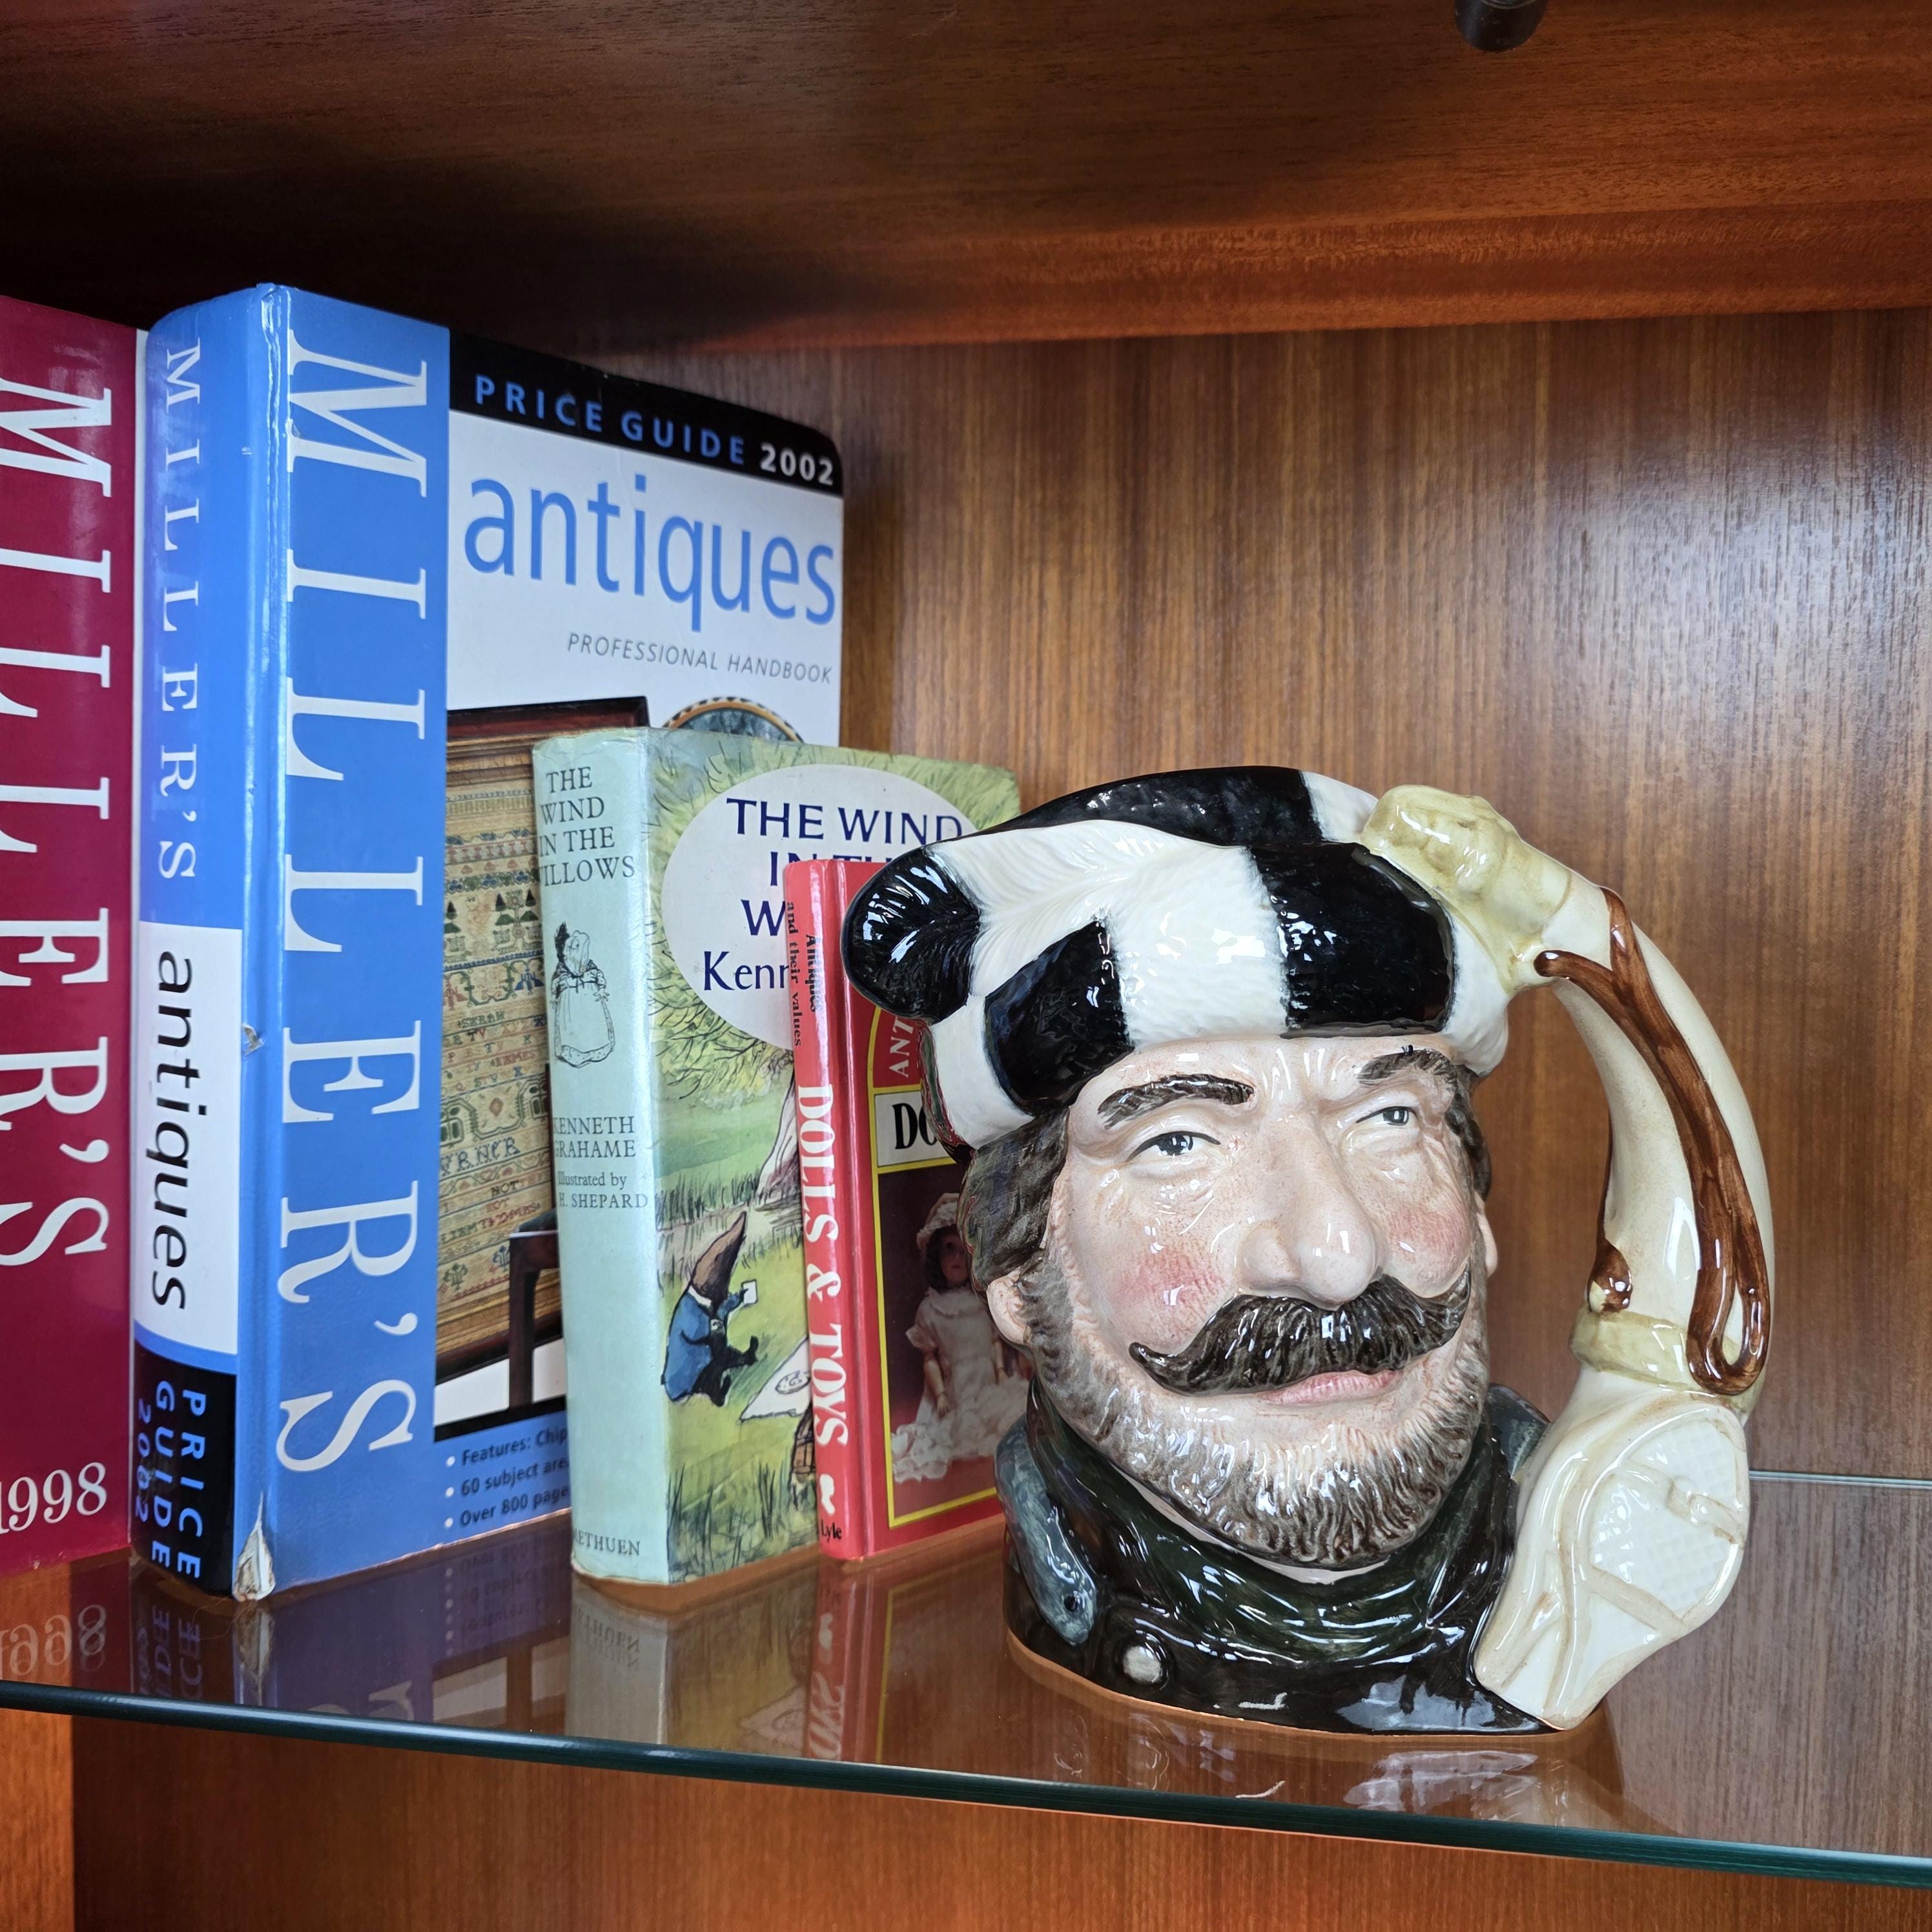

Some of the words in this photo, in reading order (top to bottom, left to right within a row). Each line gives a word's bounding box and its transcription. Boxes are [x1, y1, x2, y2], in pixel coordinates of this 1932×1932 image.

[475, 374, 602, 432] PRICE
[621, 411, 745, 465] GUIDE
[760, 443, 834, 486] 2002
[464, 474, 834, 633] antiques
[158, 337, 201, 879] MILLER'S
[567, 633, 719, 670] PROFESSIONAL
[728, 654, 833, 684] HANDBOOK
[546, 766, 593, 793] THE
[0, 378, 112, 1267] MILLER'S
[540, 796, 605, 825] WIND
[726, 798, 824, 839] THE
[838, 807, 962, 845] WIND
[539, 834, 557, 858] IN
[563, 826, 615, 852] THE
[540, 856, 635, 887] ILLOWS
[276, 330, 427, 1472] MILLER'S
[787, 902, 799, 934] and
[789, 942, 800, 983] their
[792, 992, 803, 1047] values
[146, 951, 207, 1310] antiques
[558, 1171, 606, 1186] Illustrated
[610, 1172, 627, 1190] by
[798, 1084, 839, 1243] DOLLS
[571, 1193, 648, 1208] SHEPARD
[806, 1262, 841, 1300] &
[808, 1324, 849, 1446] TOYS
[135, 1397, 152, 1523] 2002
[151, 1381, 175, 1568] GUIDE
[462, 1437, 531, 1466] Features:
[177, 1389, 207, 1579] PRICE
[461, 1477, 480, 1496] 60
[485, 1462, 539, 1490] subject
[460, 1505, 497, 1526] Over
[501, 1493, 529, 1514] 800
[821, 1519, 843, 1543] Lyle
